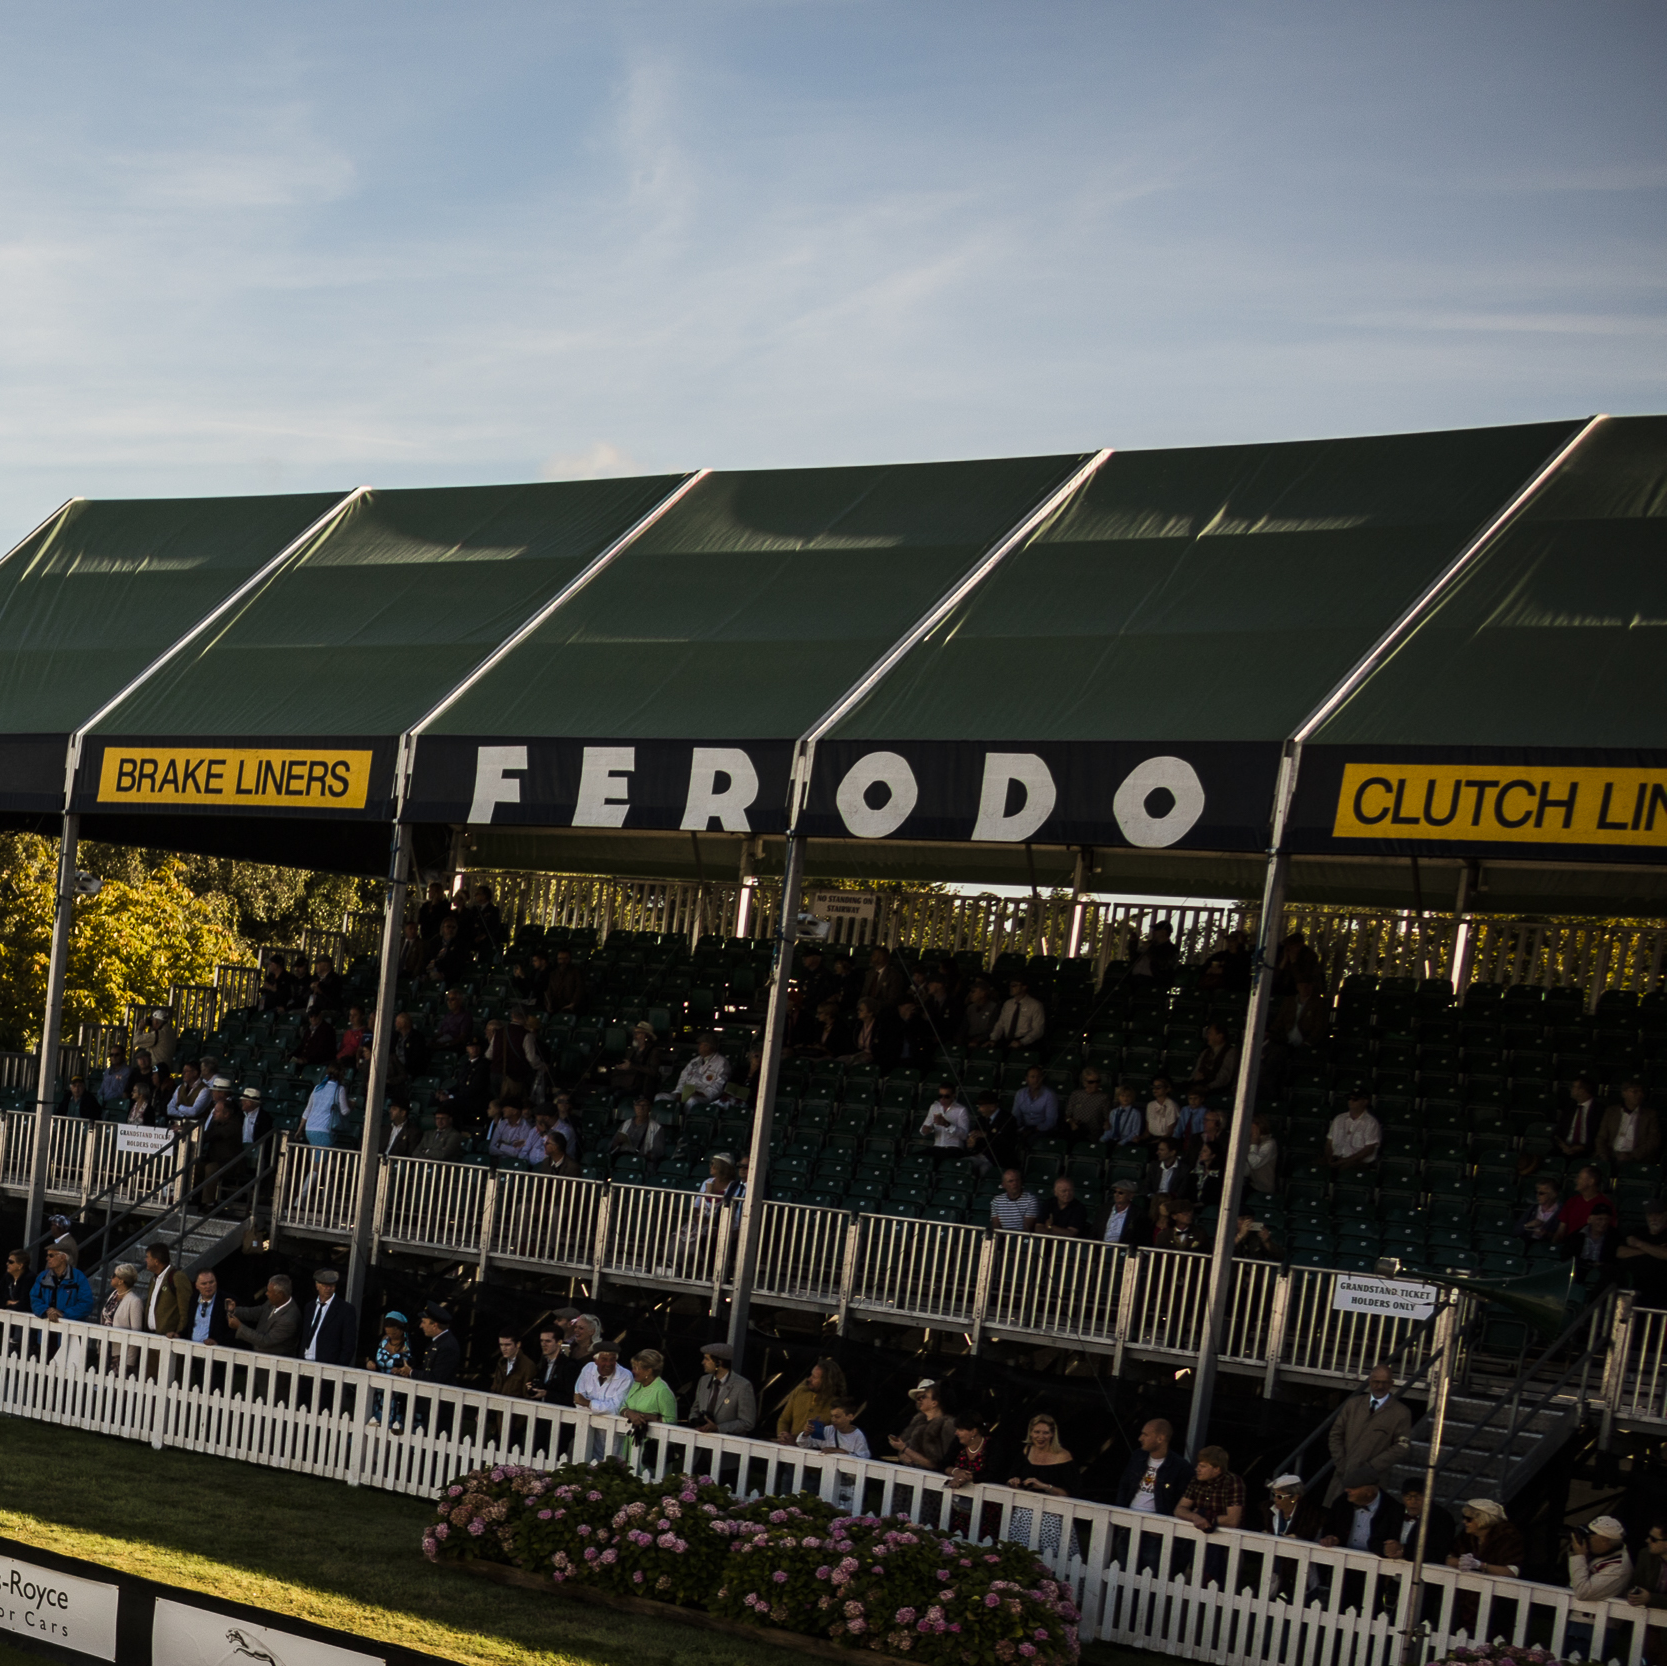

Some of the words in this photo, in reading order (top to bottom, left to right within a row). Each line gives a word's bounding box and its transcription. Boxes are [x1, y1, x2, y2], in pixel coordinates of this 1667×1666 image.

[116, 756, 226, 795] BRAKE
[236, 759, 351, 799] LINERS
[466, 745, 1205, 849] FERODO
[1352, 775, 1580, 831] CLUTCH
[816, 894, 827, 902] NO
[828, 895, 862, 904] STANDING
[863, 897, 874, 905] ON
[826, 905, 861, 914] STAIRWAY
[120, 1129, 153, 1139] GRANDSTAND
[126, 1140, 149, 1149] HOLDERS
[1339, 1282, 1398, 1296] GRANDSTAND
[1400, 1289, 1432, 1300] TICKET
[1351, 1296, 1391, 1309] HOLDERS
[1392, 1301, 1417, 1311] ONLY
[24, 1609, 70, 1638] Cars
